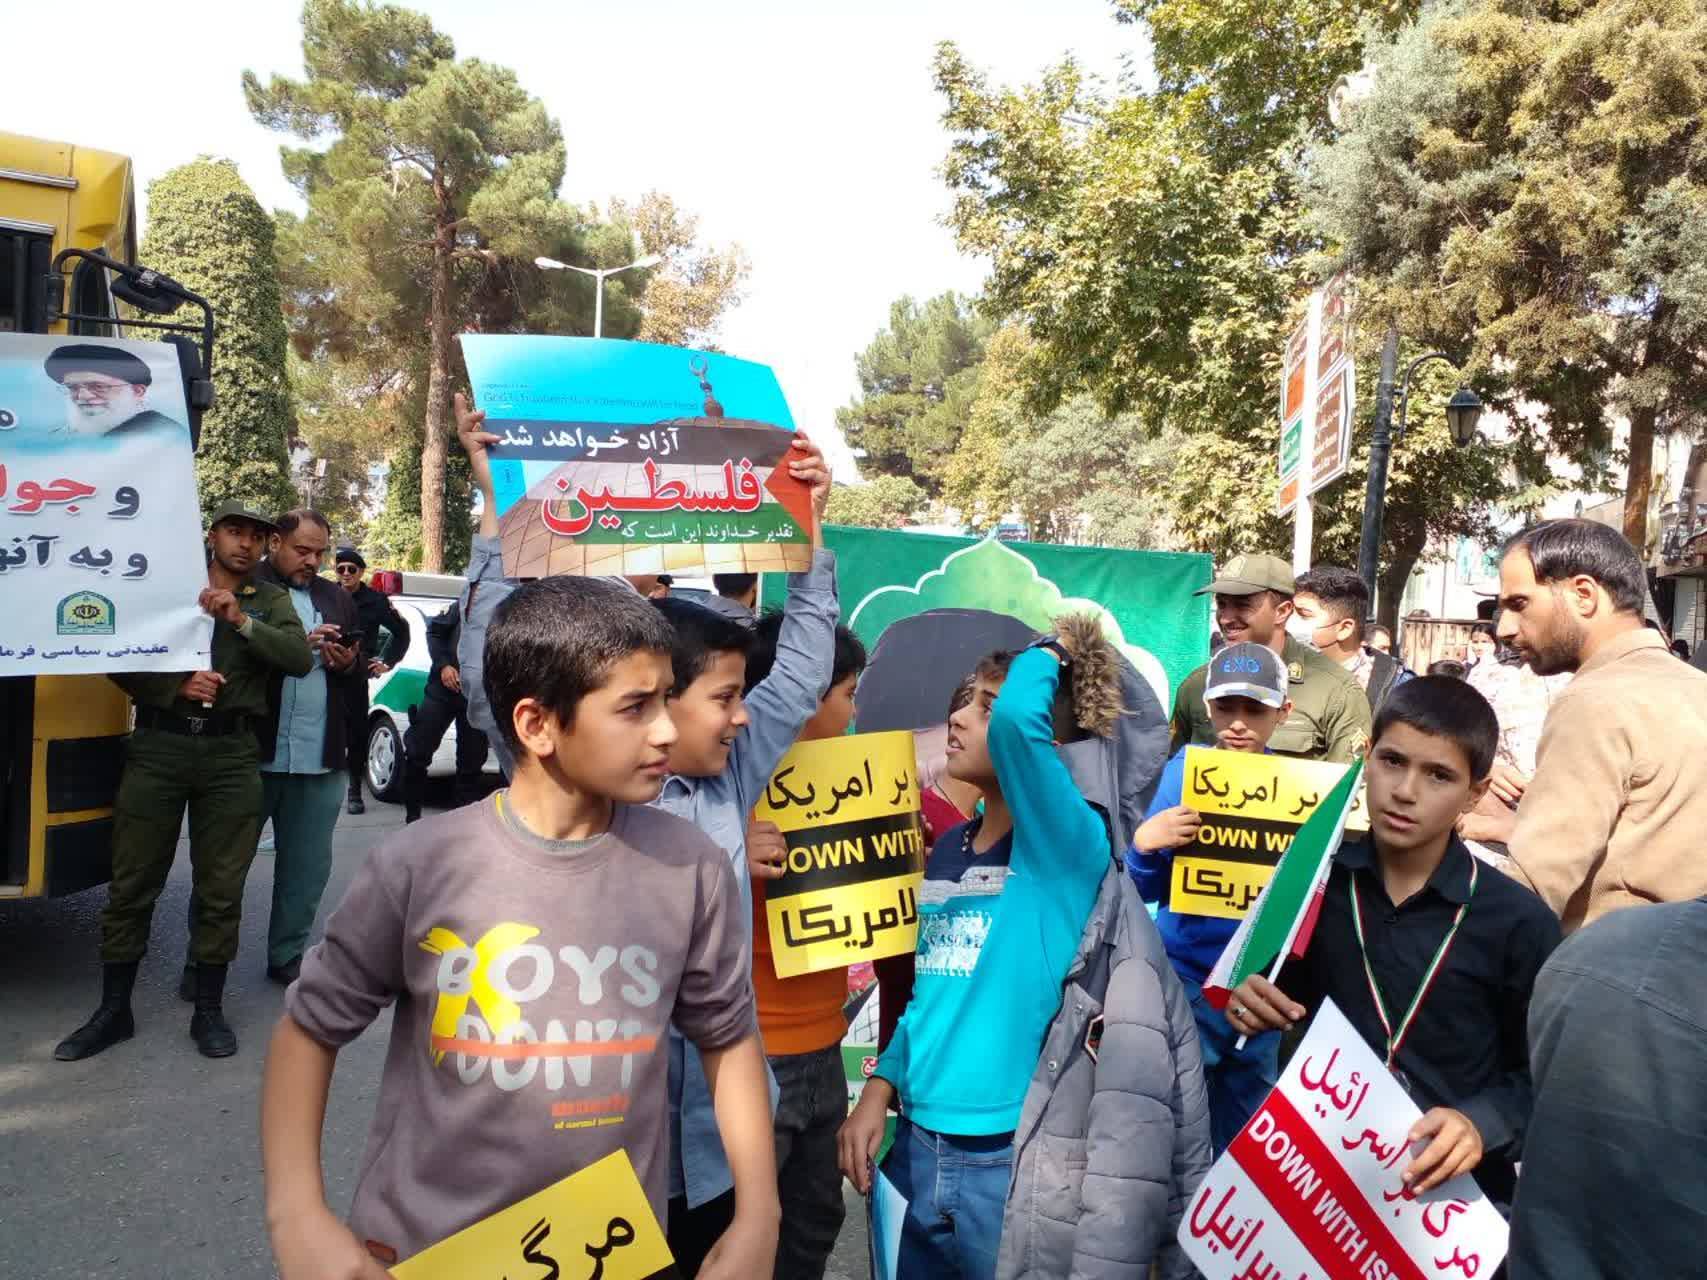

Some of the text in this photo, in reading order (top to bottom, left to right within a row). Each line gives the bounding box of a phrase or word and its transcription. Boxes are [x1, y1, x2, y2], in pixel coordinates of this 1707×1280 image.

[499, 425, 680, 457] آزاد خواهد شد
[107, 485, 140, 516] و
[541, 457, 762, 536] فلسطین
[621, 520, 794, 544] تقدیر خداوند این است که
[68, 545, 113, 575] به
[121, 552, 149, 578] و
[42, 645, 101, 659] سیاسی
[106, 645, 169, 658] عقیدتی
[766, 759, 874, 820] امریکا
[889, 769, 911, 806] بر
[1192, 766, 1279, 810] امریکا
[782, 827, 923, 874] OWN WITH
[1198, 824, 1258, 850] OWN
[436, 943, 661, 1008] BOYS
[456, 1014, 643, 1091] DON'T
[1299, 1047, 1417, 1170] اسرائیل
[1247, 1111, 1323, 1201] DOWN
[1312, 1188, 1369, 1263] WITH
[520, 1216, 635, 1280] مرگ
[1421, 1198, 1480, 1279] مرگ
